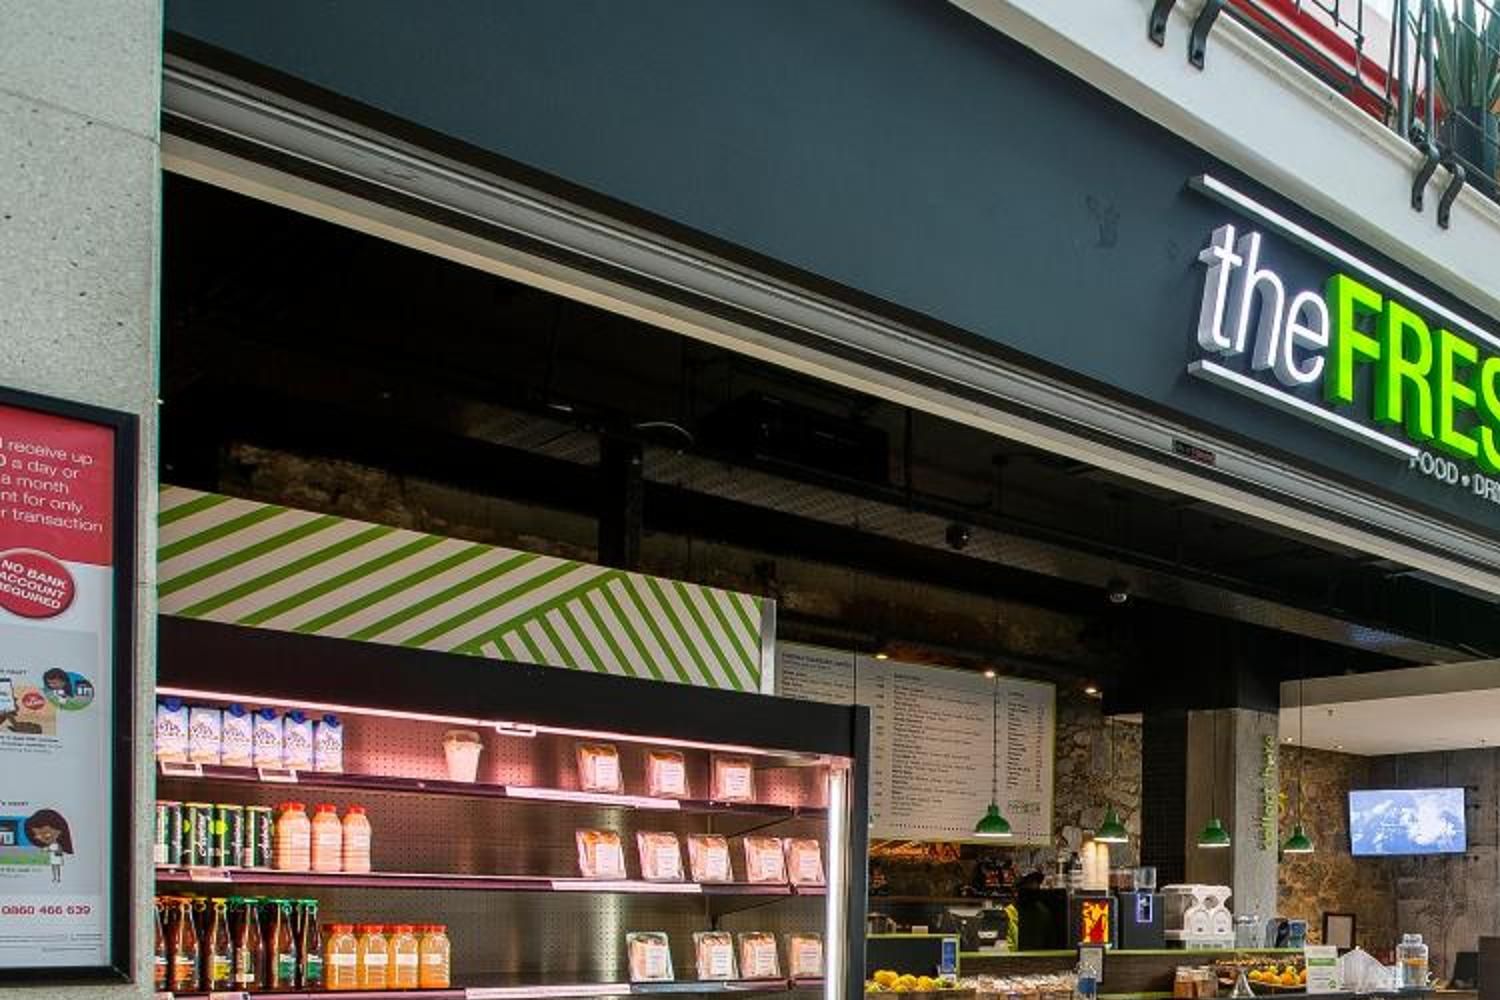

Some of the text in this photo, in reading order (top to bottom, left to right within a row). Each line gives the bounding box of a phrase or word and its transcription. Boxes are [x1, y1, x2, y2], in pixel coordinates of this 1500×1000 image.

[8, 441, 67, 460] receive
[71, 452, 93, 467] up
[11, 459, 22, 470] a
[27, 460, 57, 477] day
[62, 467, 80, 479] or
[1408, 451, 1459, 485] FOOD
[1, 473, 69, 495] a month
[23, 491, 46, 508] for
[49, 499, 83, 516] only
[12, 508, 103, 533] transaction
[0, 571, 65, 600] ACCOUNT
[2, 559, 66, 591] NO BANK
